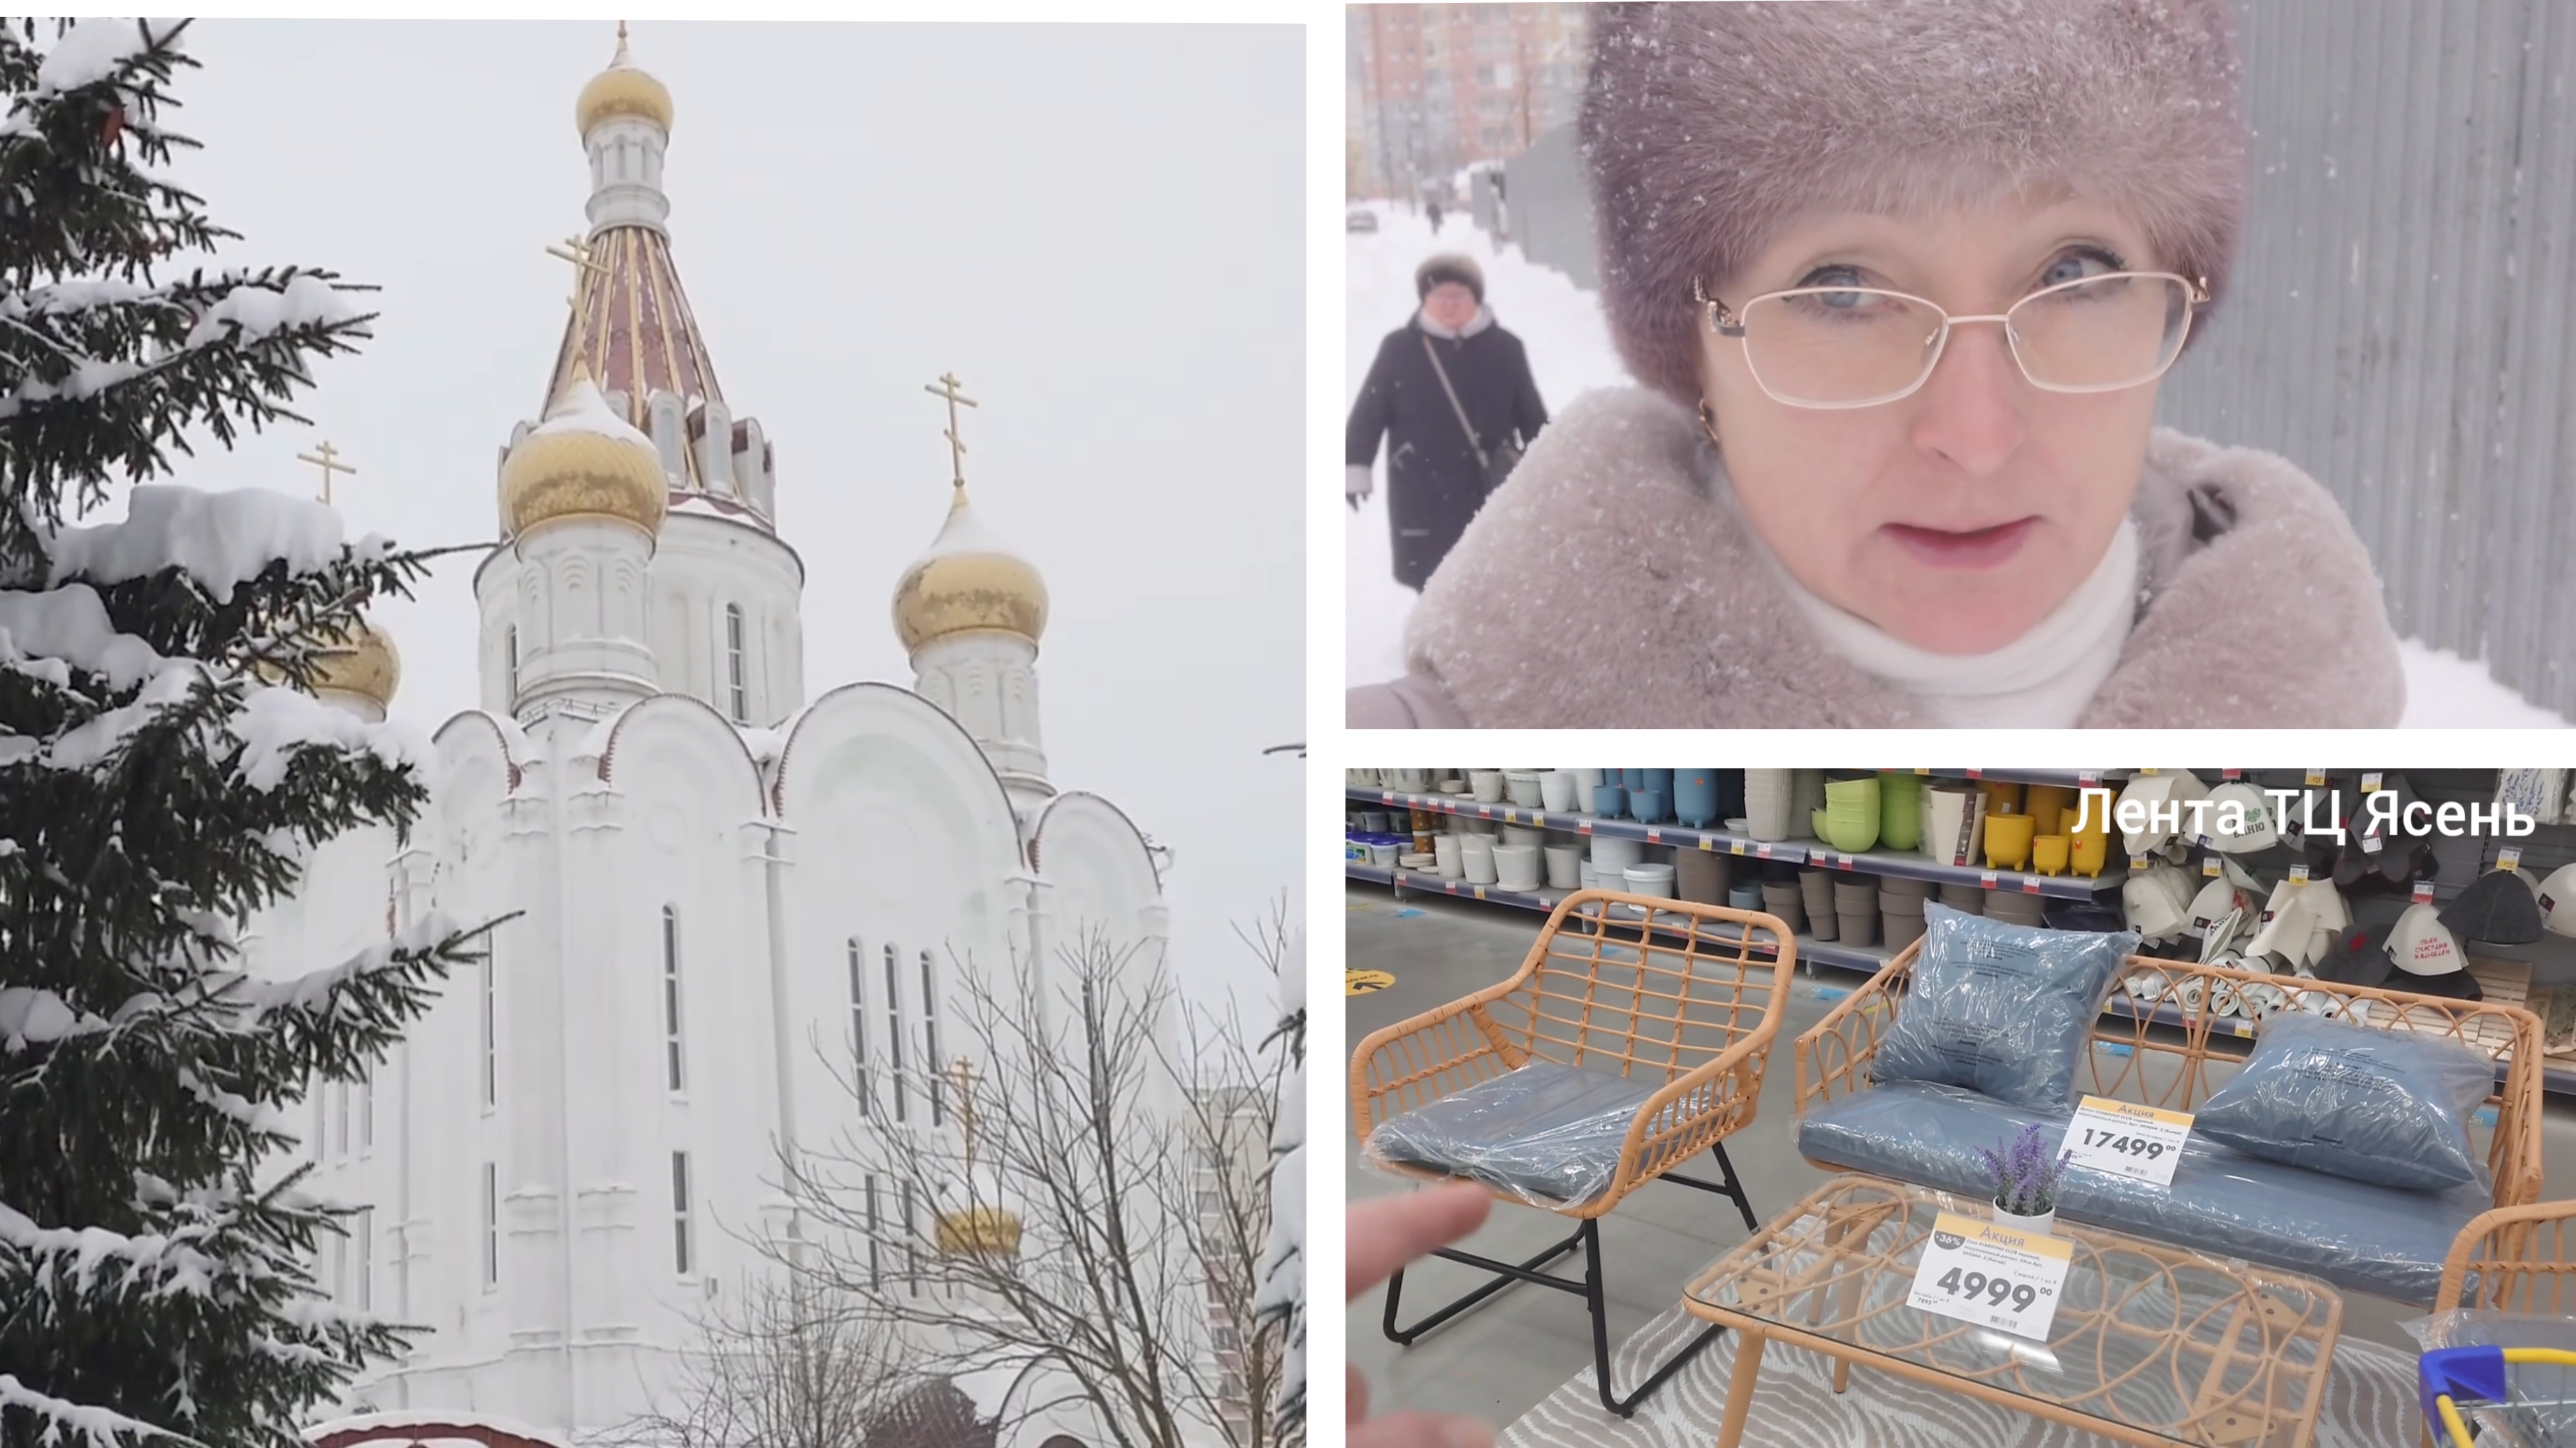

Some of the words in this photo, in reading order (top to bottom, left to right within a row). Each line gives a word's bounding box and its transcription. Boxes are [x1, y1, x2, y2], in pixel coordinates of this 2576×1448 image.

[2118, 1104, 2154, 1118] Акция
[2083, 1128, 2164, 1160] 17499
[1936, 1234, 1960, 1246] -36%
[1979, 1226, 2025, 1247] Акция
[1977, 1242, 2004, 1252] GIARDINO
[1937, 1267, 2036, 1313] 4999
[2039, 1287, 2053, 1296] 00
